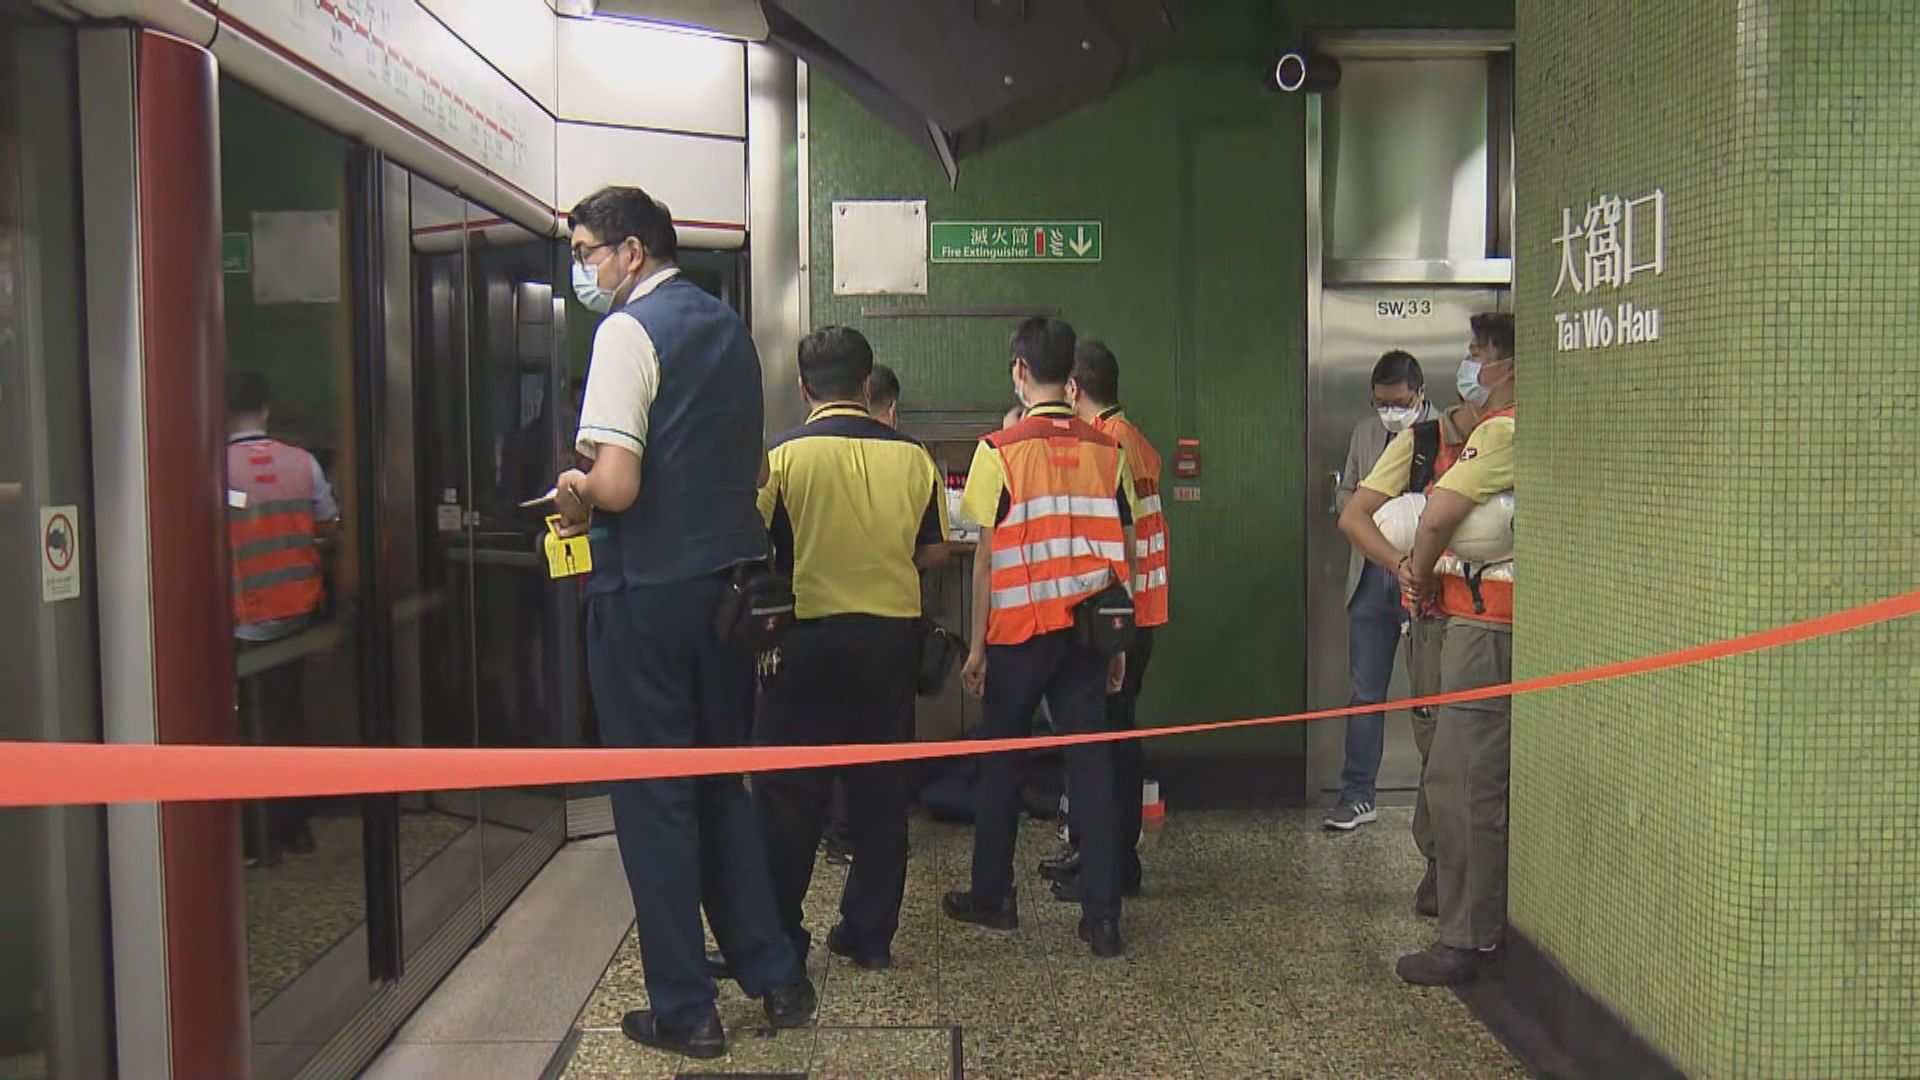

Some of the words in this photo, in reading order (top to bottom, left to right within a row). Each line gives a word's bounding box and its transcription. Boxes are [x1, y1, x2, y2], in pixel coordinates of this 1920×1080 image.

[942, 245, 962, 257] Fire
[963, 245, 1029, 259] Extinguisher
[970, 226, 1029, 246] 滅火筒
[1552, 188, 1664, 299] 大窩口
[1555, 312, 1581, 351] Tai
[1583, 307, 1614, 349] Wo
[1617, 301, 1660, 346] Hau
